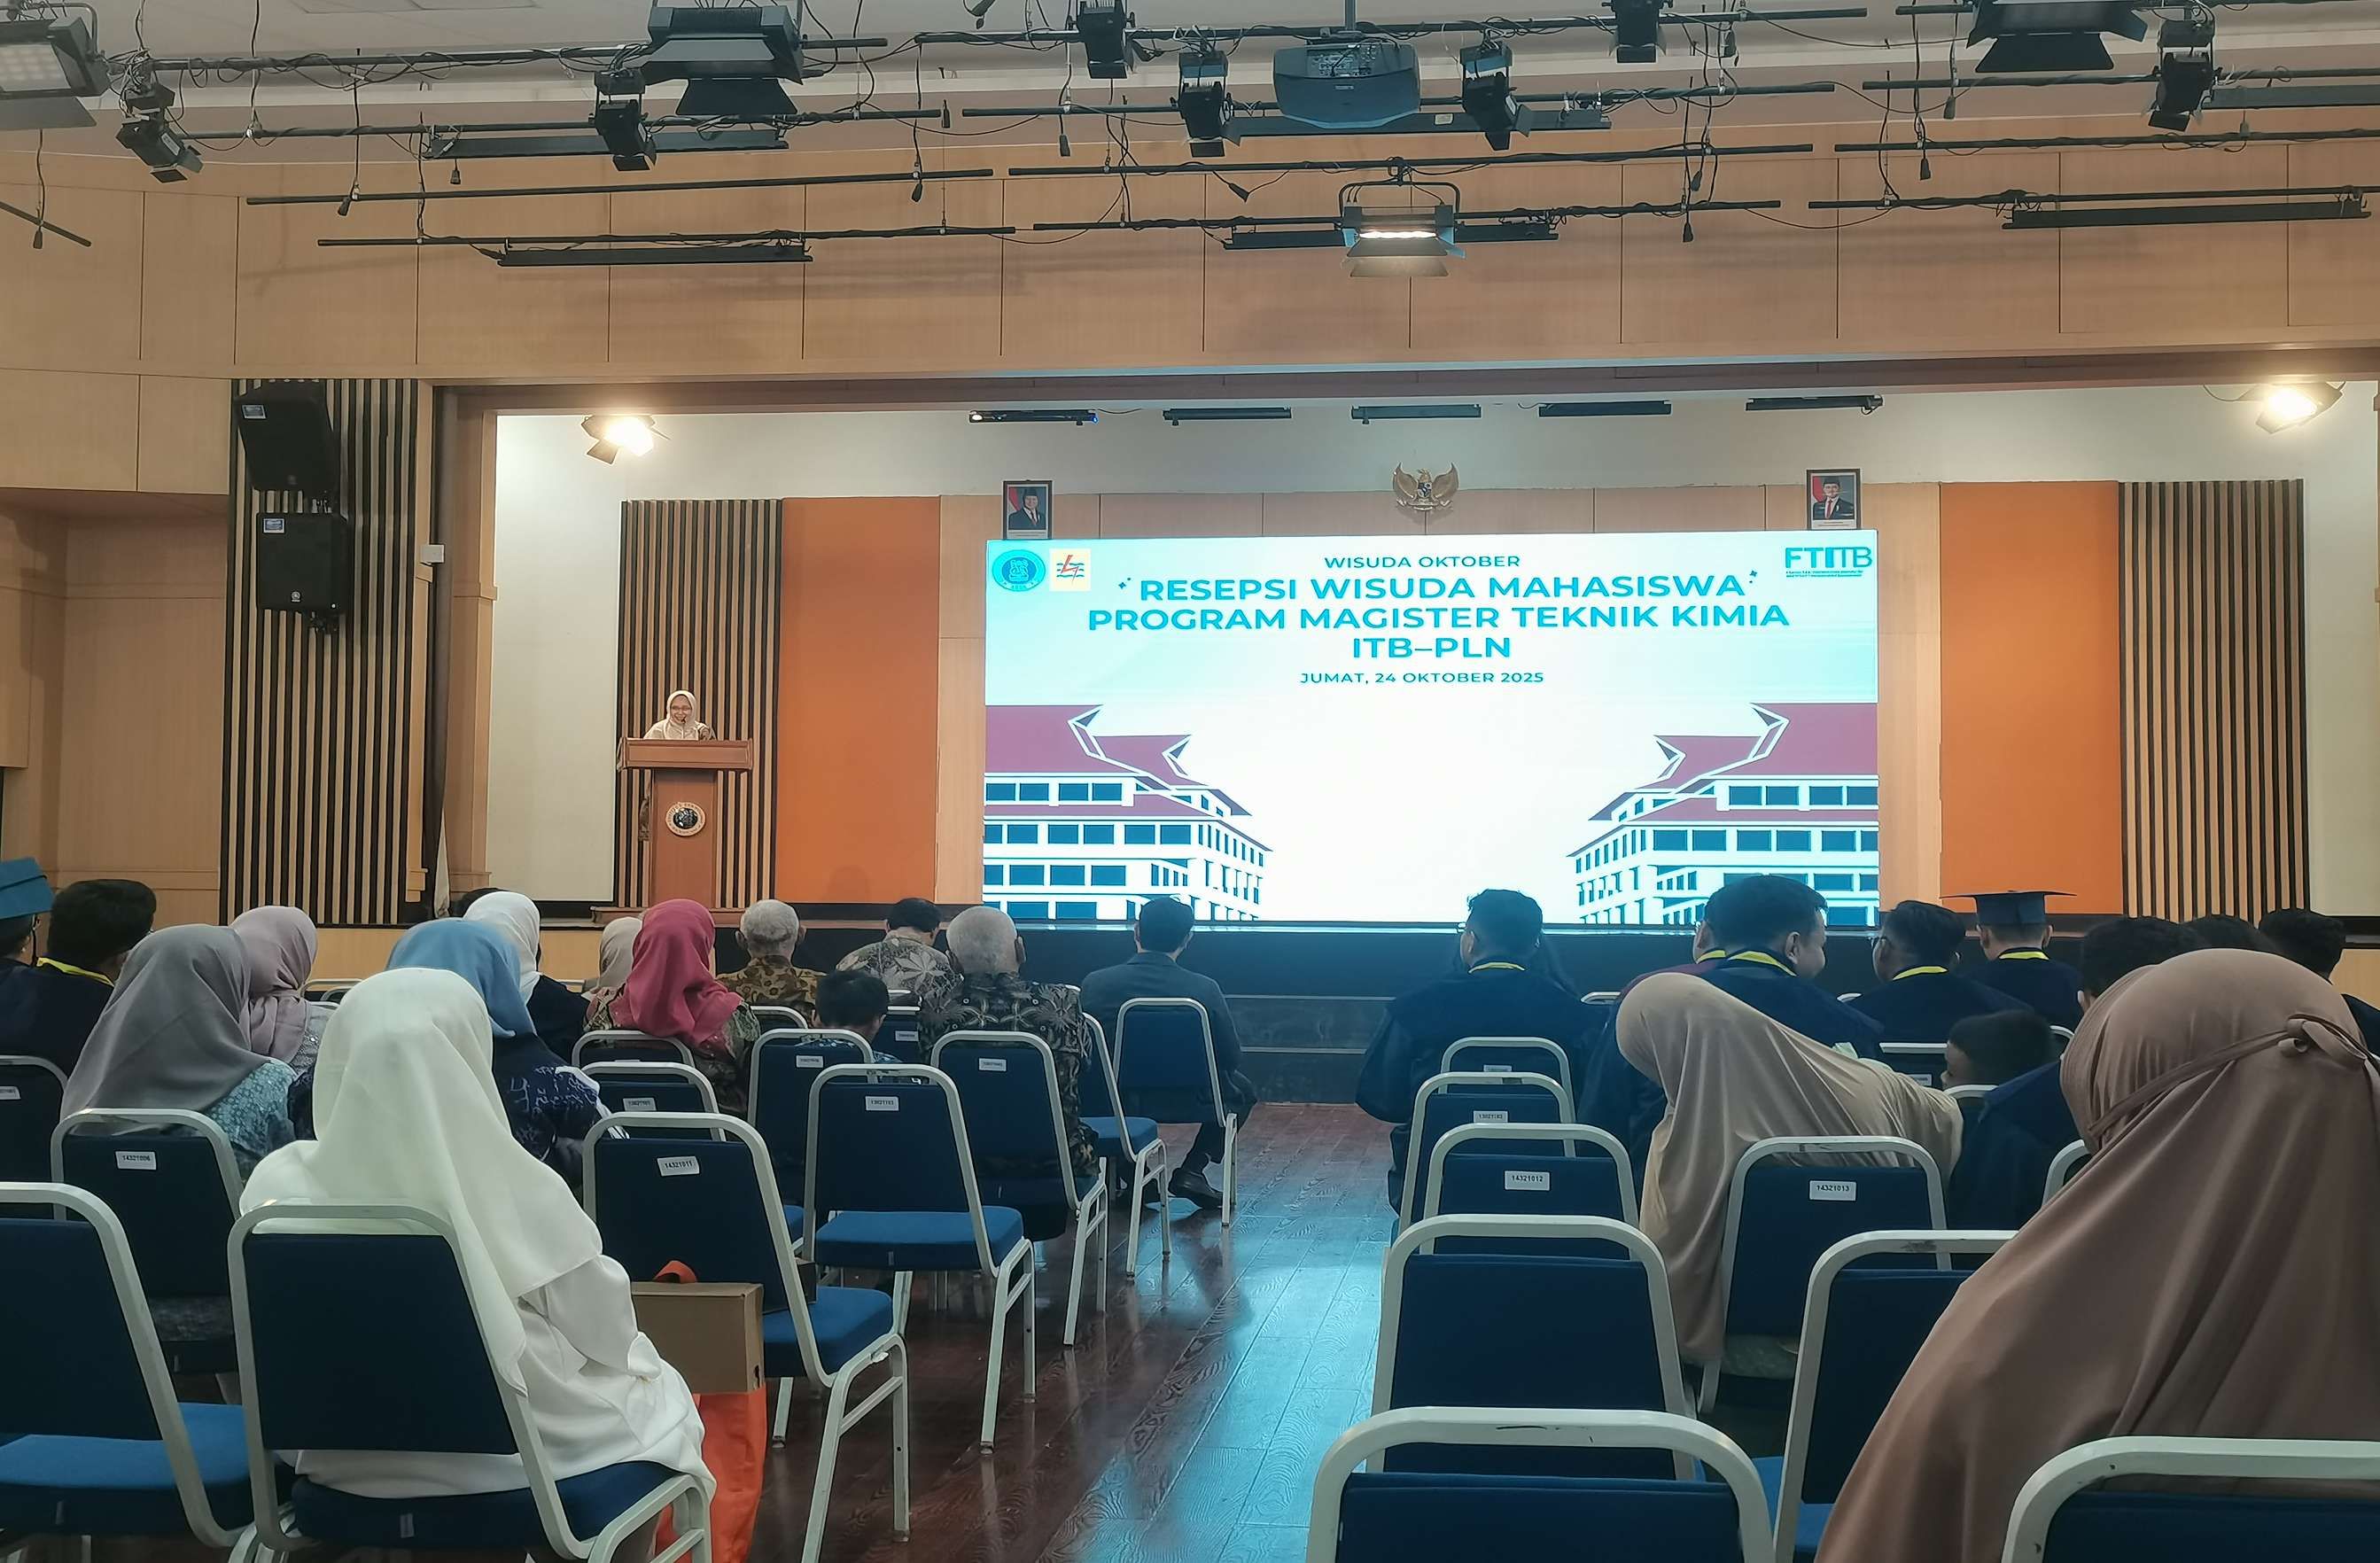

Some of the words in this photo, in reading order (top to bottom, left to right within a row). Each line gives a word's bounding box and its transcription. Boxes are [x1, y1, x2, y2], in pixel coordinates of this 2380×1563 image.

[1324, 556, 1412, 569] WISUDA
[1417, 555, 1521, 568] OKTOBER
[1139, 578, 1297, 602] RESEPSI
[1310, 577, 1476, 600] WISUDA
[1489, 575, 1746, 598] MAHASISWA
[1088, 609, 1286, 632] PROGRAM
[1300, 607, 1500, 630] MAGISTER
[1511, 606, 1660, 628] TEKNIK
[1672, 604, 1791, 627] KIMIA
[1300, 672, 1369, 686] JUMAT,
[1374, 672, 1396, 684] 24
[1402, 672, 1496, 684] OKTOBER
[1500, 672, 1544, 684] 2025
